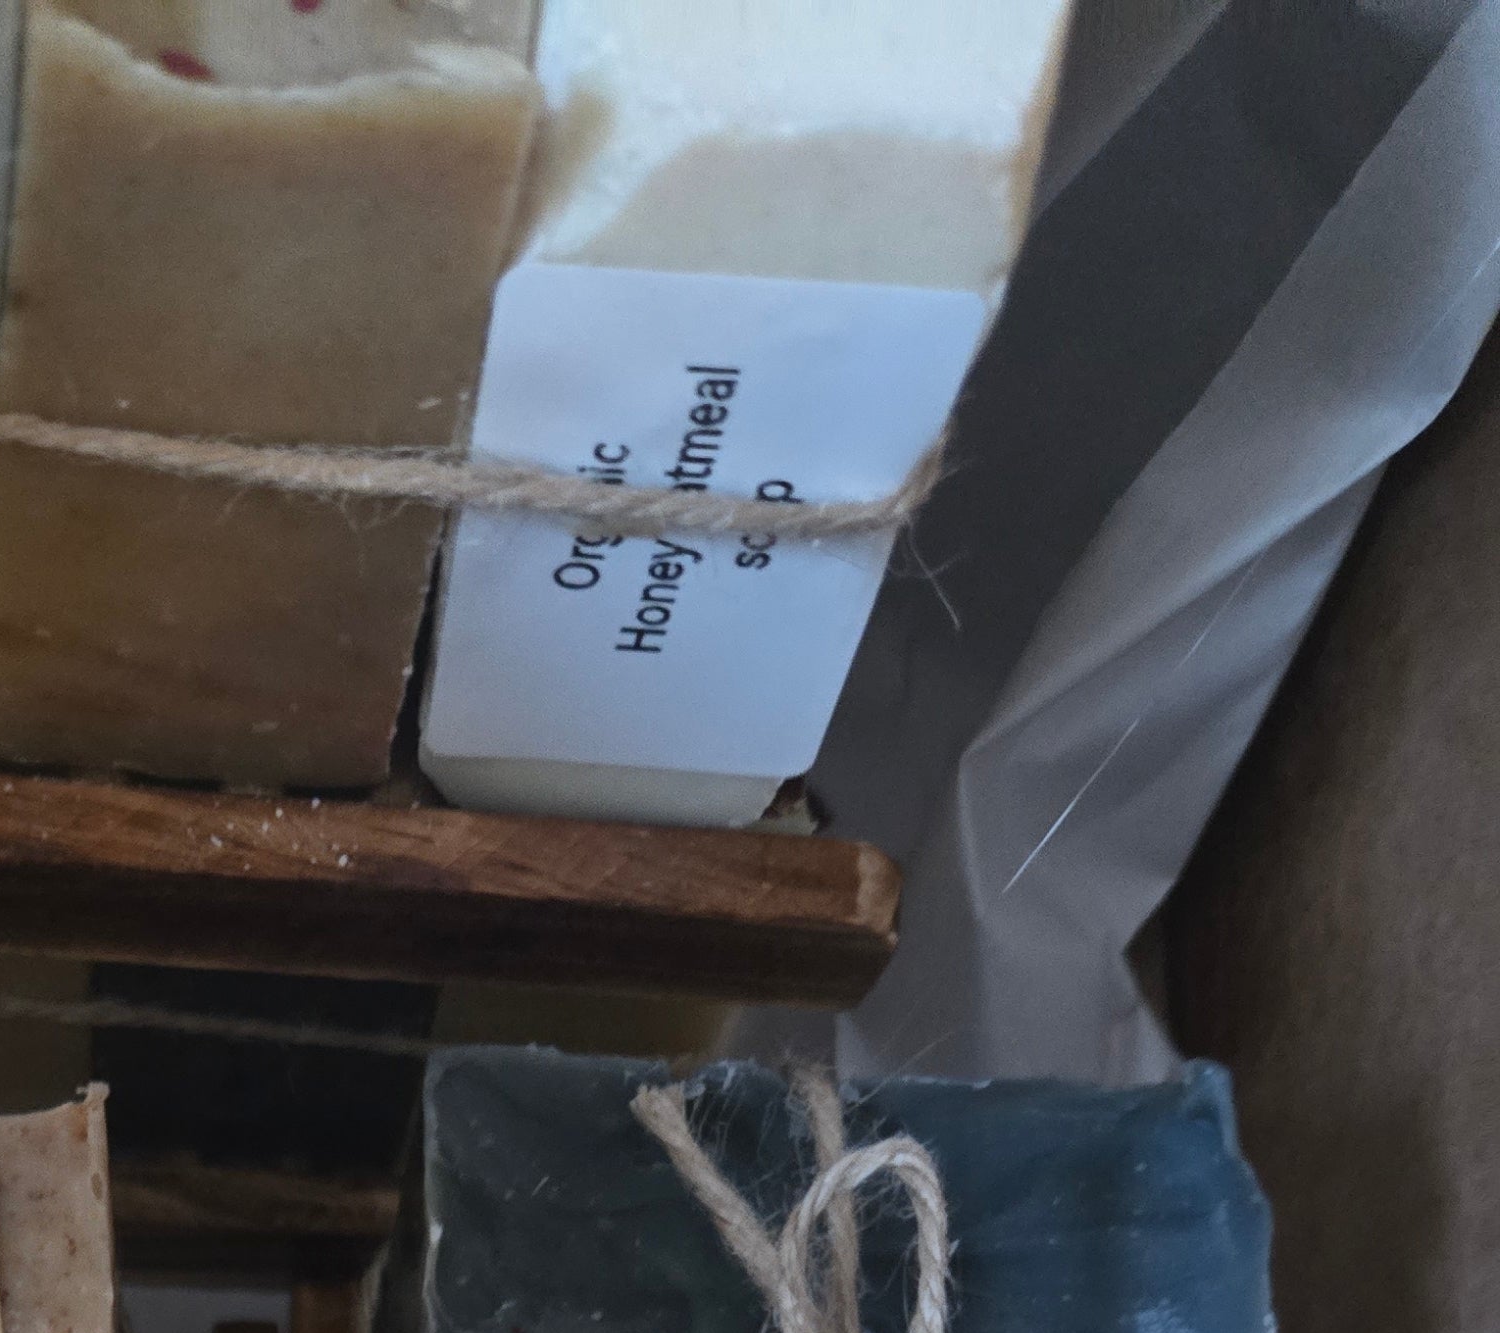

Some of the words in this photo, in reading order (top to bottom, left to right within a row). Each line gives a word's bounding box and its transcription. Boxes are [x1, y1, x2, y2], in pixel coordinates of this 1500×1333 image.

[553, 443, 630, 591] Orgic
[614, 539, 702, 653] Honey
[664, 365, 741, 494] tmeal
[733, 480, 804, 571] sop
